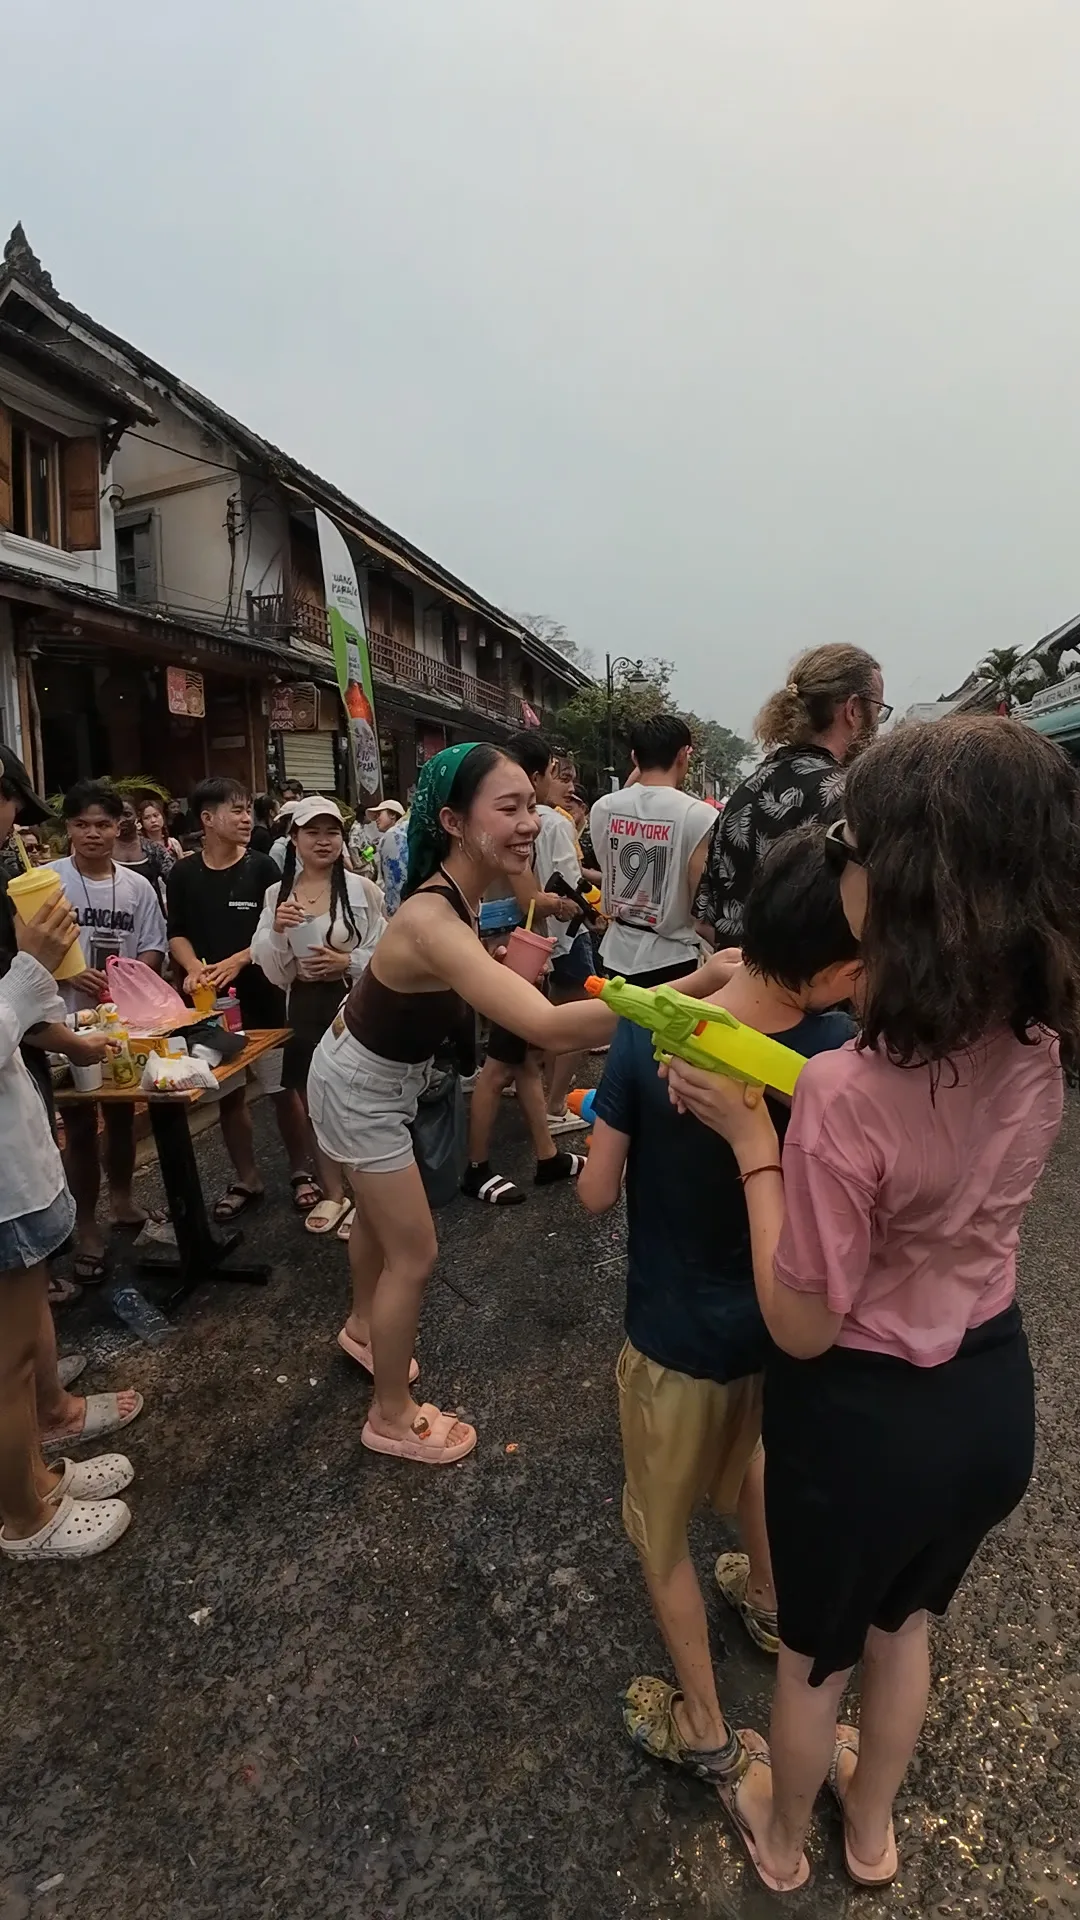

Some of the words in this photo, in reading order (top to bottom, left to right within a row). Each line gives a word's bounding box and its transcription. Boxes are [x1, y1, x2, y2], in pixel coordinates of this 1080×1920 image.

[610, 819, 639, 837] NEW
[639, 823, 671, 841] YORK
[609, 837, 619, 850] 19
[619, 841, 667, 905] 91
[72, 907, 135, 932] LENCIAGA
